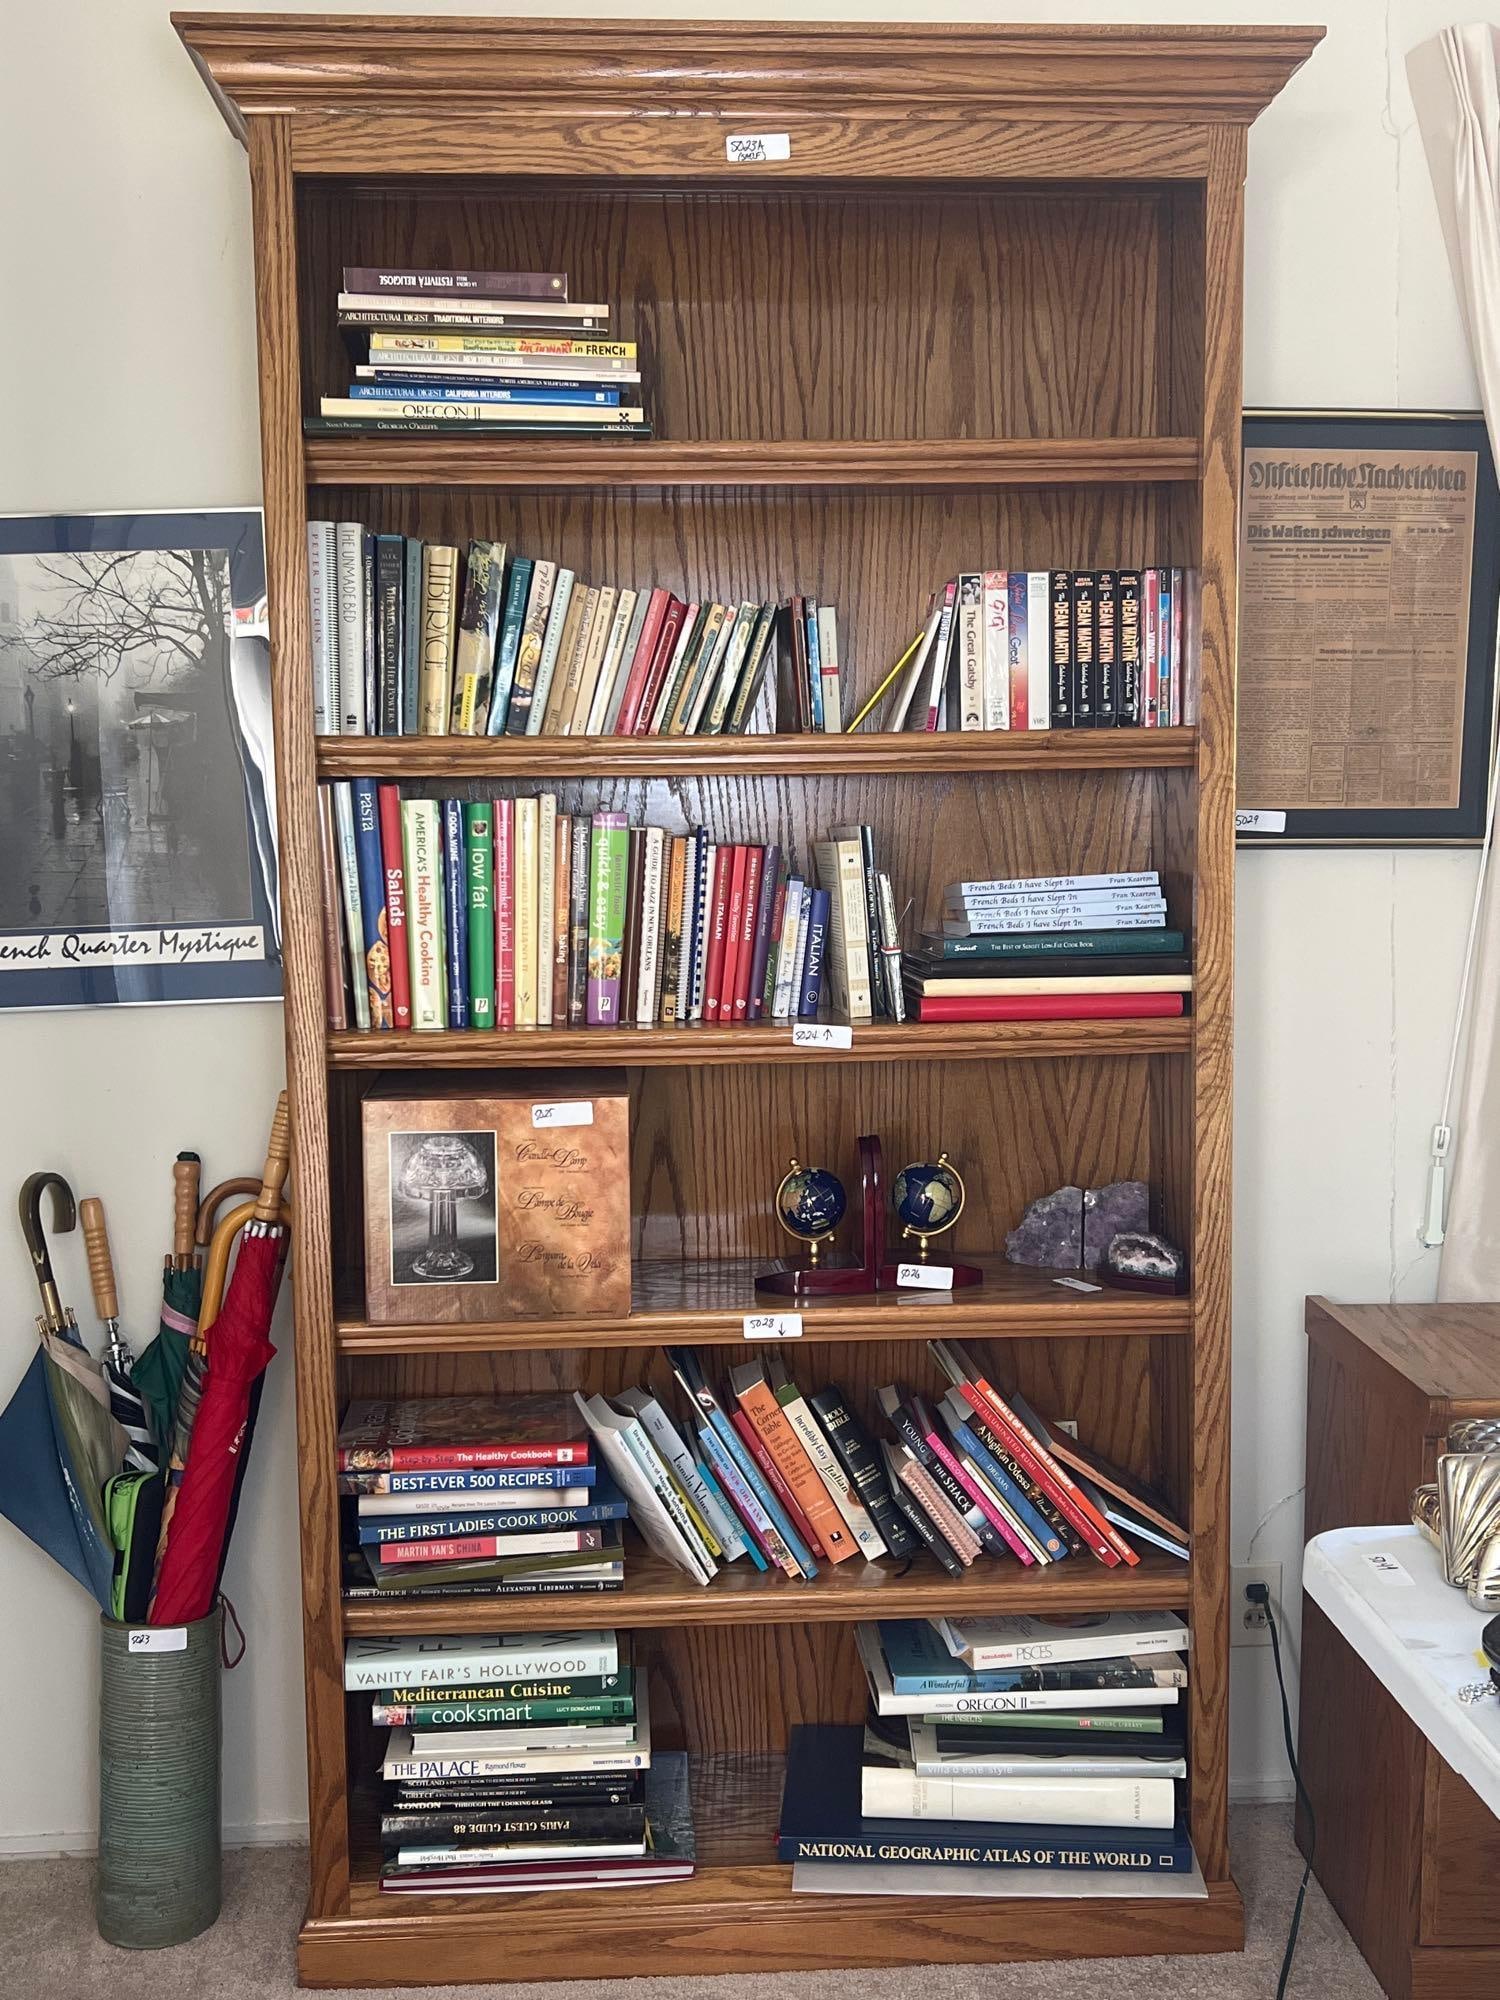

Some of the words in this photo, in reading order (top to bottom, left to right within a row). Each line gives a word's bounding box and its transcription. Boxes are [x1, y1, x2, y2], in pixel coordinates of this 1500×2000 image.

[379, 275, 416, 286] RELIGIOSE
[418, 275, 453, 288] FESTIVITÀ
[345, 312, 401, 323] ARCHITECTURAL
[403, 313, 429, 323] DIGEST
[433, 315, 472, 323] TRADITIONAL
[473, 316, 505, 325] INTERIORS
[518, 339, 574, 354] DICTIONARY
[575, 345, 583, 353] in
[586, 345, 626, 356] FRENCH
[359, 387, 416, 397] ARCHITECTURAL
[417, 388, 442, 398] DIGEST
[444, 390, 480, 398] CALIFORNIA
[480, 390, 511, 399] INTERIORS
[402, 404, 469, 420] OREGON
[342, 529, 356, 546] THE
[1247, 525, 1270, 539] Die
[1271, 525, 1320, 539] Waffen
[1321, 525, 1392, 541] schweigen
[312, 533, 321, 578] PETER
[342, 549, 357, 601] UNMADE
[313, 587, 323, 644] DUCHIN
[343, 602, 357, 624] BED
[423, 562, 452, 673] LIBERACE
[966, 610, 976, 627] The
[1054, 602, 1069, 627] DEAN
[1077, 600, 1092, 626] DEAN
[1099, 601, 1114, 626] DEAN
[1122, 599, 1137, 625] DEAN
[386, 601, 397, 650] MEASURE
[966, 630, 977, 657] Great
[1010, 636, 1022, 667] Great
[1054, 629, 1069, 665] MARTIN
[1077, 627, 1092, 663] MARTIN
[1099, 628, 1114, 664] MARTIN
[1122, 626, 1137, 662] MARTIN
[1148, 632, 1157, 664] VINNY
[387, 651, 396, 664] OF
[387, 665, 396, 687] HER
[964, 658, 977, 690] Gatsby
[386, 688, 396, 724] POWERS
[414, 812, 428, 873] AMERICA'S
[472, 847, 488, 880] low
[594, 838, 612, 878] quick
[651, 845, 660, 872] GUIDE
[599, 879, 611, 892] &
[650, 873, 658, 885] TO
[1127, 875, 1154, 883] Kearton
[386, 868, 404, 928] Salads
[416, 875, 433, 927] Healthy
[472, 884, 488, 910] fat
[649, 886, 657, 904] JAZZ
[593, 896, 610, 932] easy
[648, 906, 656, 915] IN
[714, 902, 726, 941] ITALIAN
[743, 903, 755, 942] ITALIAN
[647, 915, 656, 934] NEW
[61, 934, 152, 962] Quarter
[159, 930, 259, 962] Mystique
[556, 934, 569, 963] baking
[644, 935, 655, 972] ORLEANS
[808, 924, 824, 976] ITALIAN
[954, 944, 978, 952] Sunset
[749, 1318, 775, 1329] 5028
[750, 1403, 766, 1417] The
[756, 1407, 782, 1426] Corner
[823, 1407, 844, 1422] HOLY
[825, 1413, 851, 1432] BIBLE
[761, 1420, 783, 1436] Table
[794, 1414, 819, 1446] Incredibly
[815, 1443, 828, 1460] Easy
[902, 1419, 928, 1453] YOUNG
[971, 1394, 983, 1411] THE
[982, 1409, 1021, 1456] ILLUMINATED
[1020, 1453, 1037, 1471] RUMI
[985, 1388, 1015, 1423] ANIMALS
[1012, 1419, 1022, 1431] OF
[1019, 1428, 1033, 1442] THE
[1030, 1439, 1052, 1466] WORLD
[1048, 1461, 1076, 1491] EUROPE
[456, 1453, 473, 1462] The
[475, 1452, 509, 1462] Healthy
[510, 1450, 553, 1459] Cookbook
[719, 1425, 736, 1452] FENG
[734, 1450, 749, 1472] SHUI
[746, 1472, 769, 1498] STYLE
[977, 1425, 986, 1437] A
[983, 1431, 1002, 1456] Night
[998, 1451, 1009, 1465] in
[1007, 1461, 1031, 1490] Odessa
[392, 1475, 466, 1490] BEST-EVER
[469, 1475, 496, 1487] 500
[499, 1473, 553, 1486] RECIPES
[632, 1429, 646, 1451] Dream
[645, 1450, 656, 1469] Tours
[659, 1475, 669, 1492] Napa
[671, 1496, 688, 1525] Sonoma
[672, 1452, 693, 1489] Family
[690, 1481, 710, 1516] Values
[706, 1436, 715, 1447] THE
[713, 1446, 724, 1463] FOOD
[728, 1471, 740, 1487] NEW
[739, 1488, 764, 1523] ORLEANS
[823, 1463, 849, 1493] Italian
[933, 1462, 947, 1478] THE
[943, 1476, 972, 1512] SHACK
[987, 1463, 1010, 1491] DREAMS
[378, 1527, 406, 1540] THE
[409, 1523, 447, 1538] FIRST
[449, 1518, 495, 1535] LADIES
[497, 1514, 538, 1529] COOK
[541, 1510, 578, 1524] BOOK
[397, 1546, 429, 1558] MARTIN
[431, 1543, 455, 1556] YAN'S
[456, 1542, 481, 1553] CHINA
[372, 1588, 407, 1597] DIETRICH
[495, 1584, 537, 1592] ALEXANDER
[538, 1583, 575, 1592] LIBERMAN
[1016, 1644, 1053, 1661] PISCES
[357, 1670, 413, 1685] VANITY
[420, 1666, 472, 1682] FAIR'S
[479, 1659, 587, 1678] HOLLYWOOD
[393, 1686, 505, 1703] Mediterranean
[510, 1683, 572, 1698] Cuisine
[920, 1680, 927, 1689] A
[927, 1680, 966, 1692] Wonderful
[432, 1703, 533, 1724] cooksmart
[556, 1705, 570, 1713] LUCY
[956, 1697, 1016, 1711] OREGON
[955, 1714, 983, 1723] INSECTS
[392, 1763, 417, 1777] THE
[419, 1760, 480, 1778] PALACE
[484, 1762, 508, 1772] Raymond
[508, 1761, 527, 1769] Flower
[407, 1779, 445, 1787] SCOTLAND
[398, 1801, 441, 1810] LONDON
[453, 1824, 466, 1834] 88
[468, 1823, 501, 1833] GUIDE
[503, 1822, 538, 1833] GUEST
[541, 1821, 570, 1831] PARIS
[798, 1843, 876, 1858] NATIONAL
[879, 1845, 981, 1861] GEOGRAPHIC
[982, 1849, 1031, 1863] ATLAS
[1033, 1850, 1055, 1863] OF
[1058, 1851, 1091, 1864] THE
[1093, 1852, 1152, 1866] WORLD
